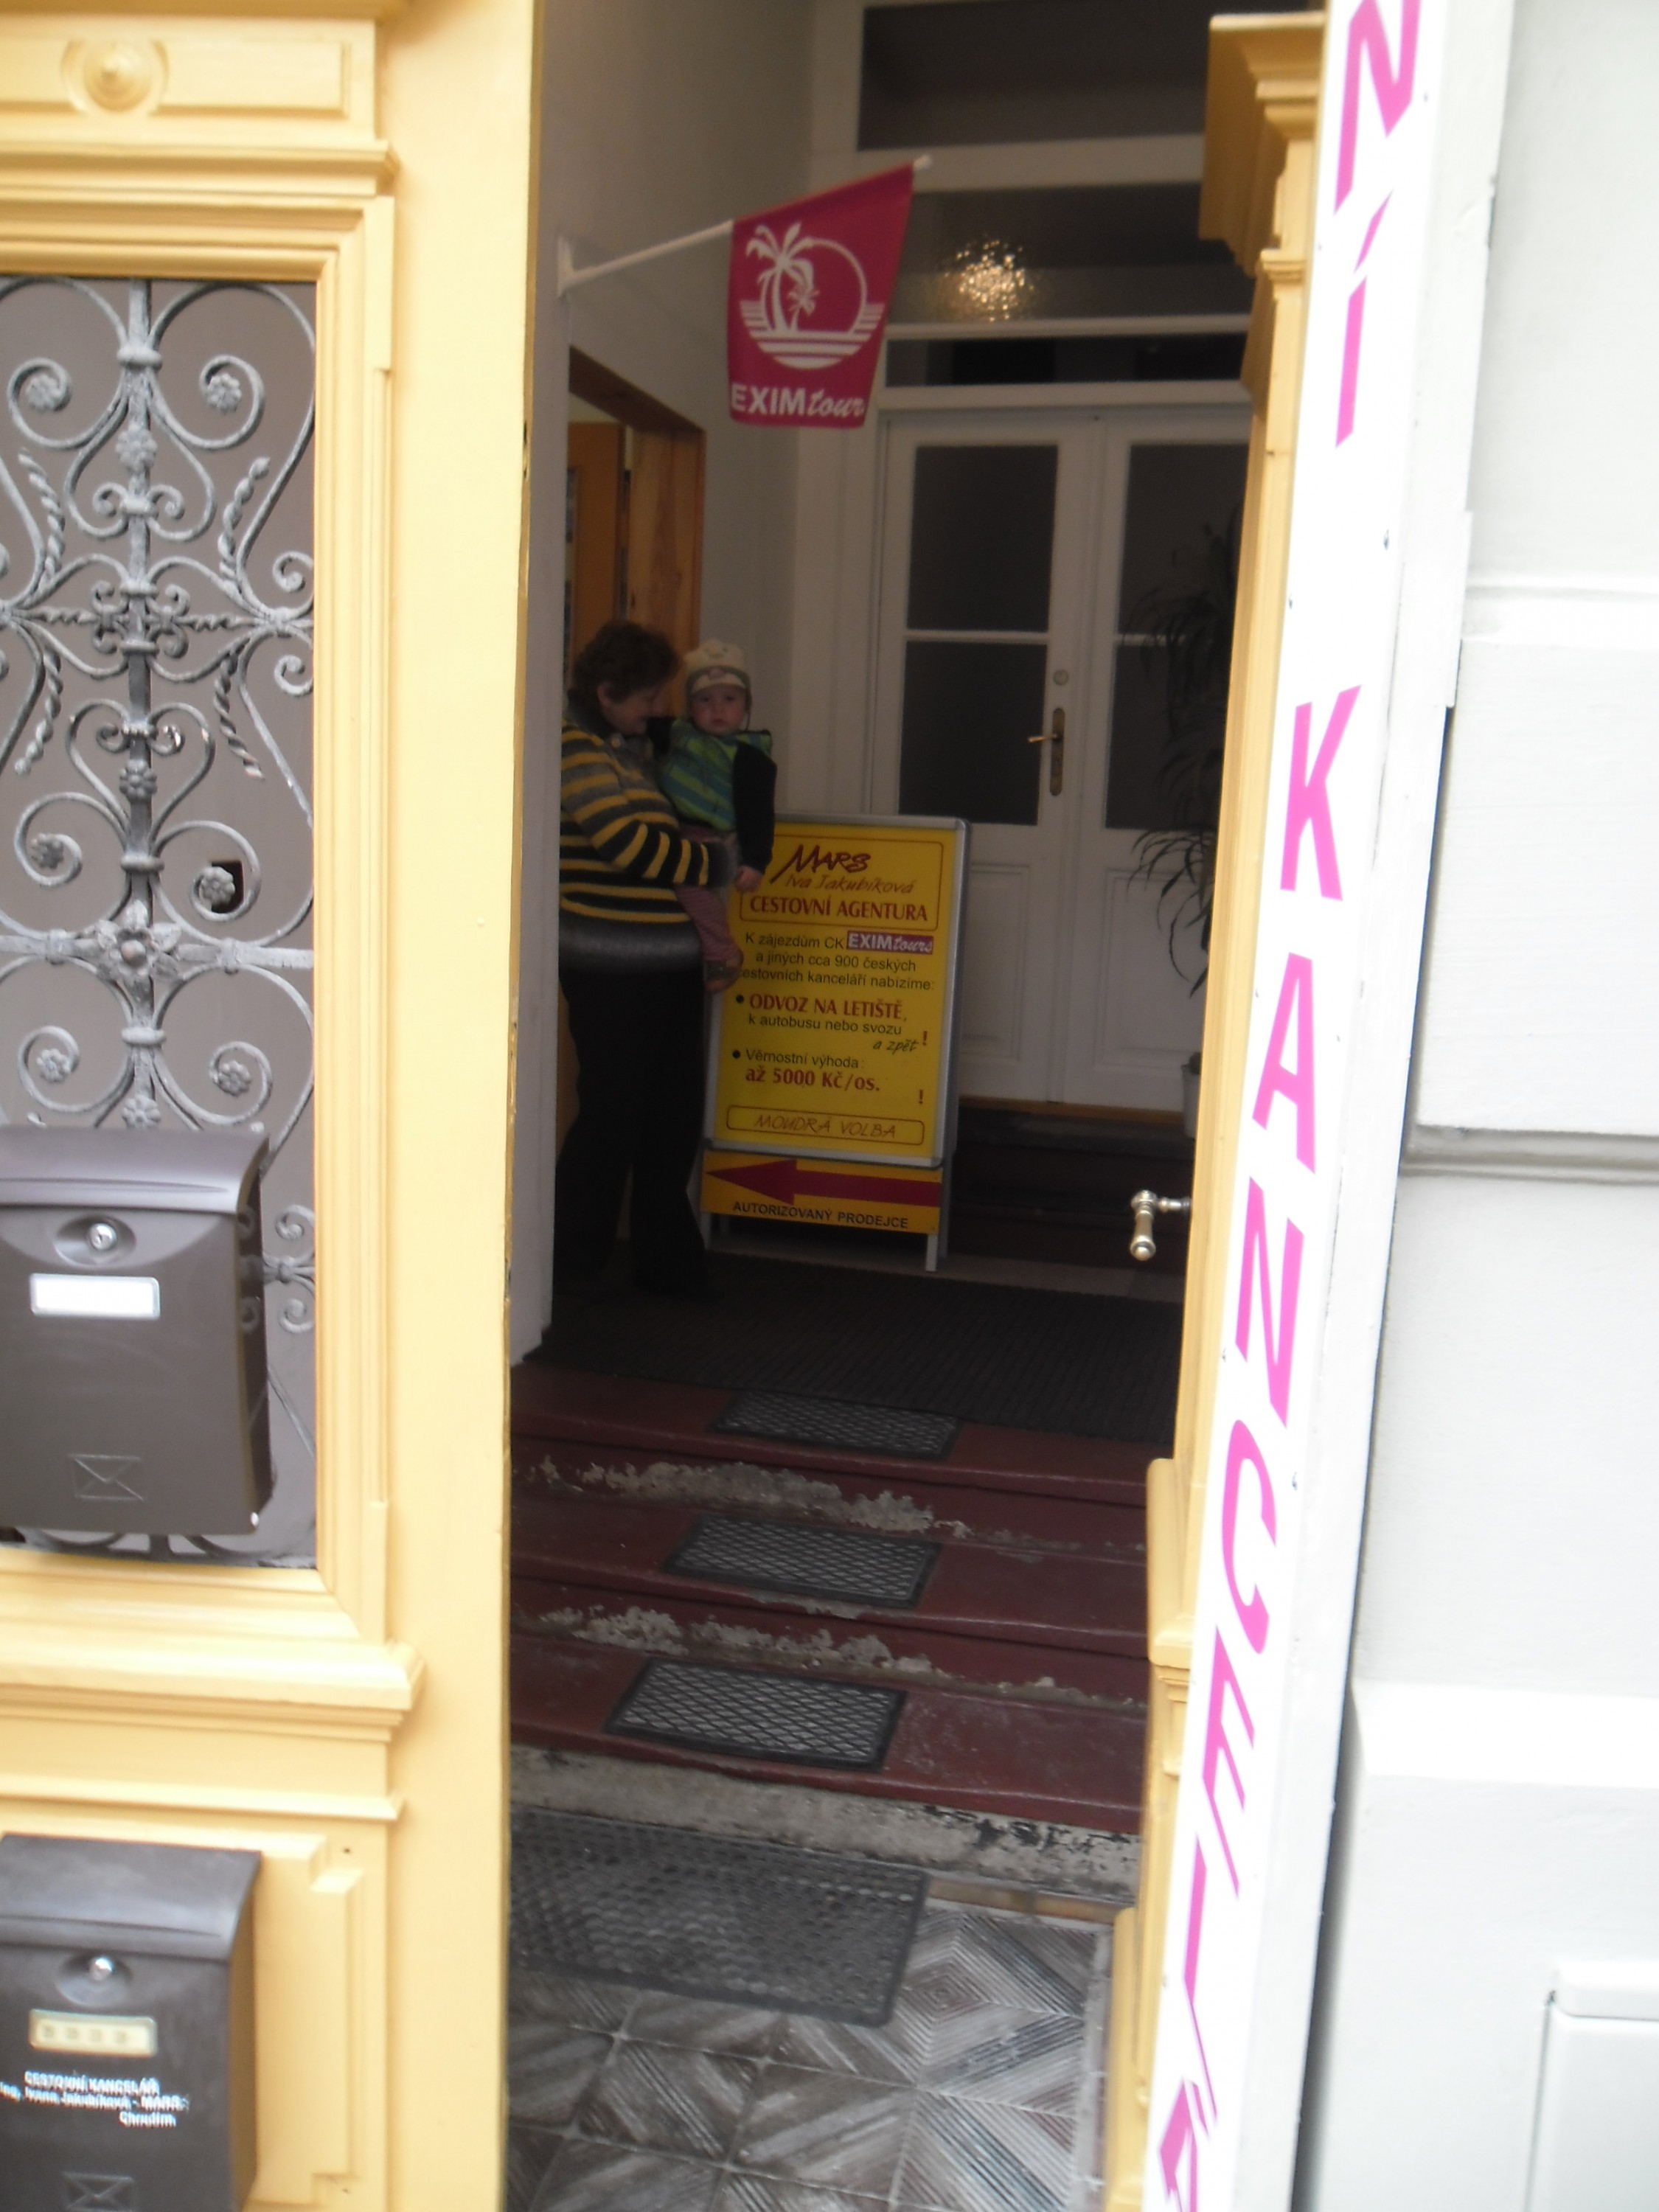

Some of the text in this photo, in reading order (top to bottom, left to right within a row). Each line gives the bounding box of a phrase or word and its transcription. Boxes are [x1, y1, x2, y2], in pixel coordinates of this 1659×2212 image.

[770, 844, 872, 885] MARS
[785, 874, 813, 890] Iva
[749, 894, 928, 922] CESTOVNÍ AGENTURA
[745, 932, 933, 953] K zájezdům CK EXIMtours
[756, 953, 917, 974] a jiných cca 900 českých
[807, 972, 866, 987] kanceláří
[871, 976, 936, 991] nabízíme:
[749, 994, 809, 1012] ODVOZ
[814, 998, 838, 1015] NA
[748, 1013, 902, 1035] k autobusu nebo svozu
[872, 1038, 919, 1055] a zpět
[922, 1030, 929, 1046] !
[745, 1048, 807, 1065] Věrnostní
[772, 1068, 815, 1087] 5000
[918, 1089, 925, 1105] !
[754, 1113, 897, 1139] MOUDRÁ VOLBA
[731, 1200, 909, 1229] AUTORIZOVANÝ PRODEJCE
